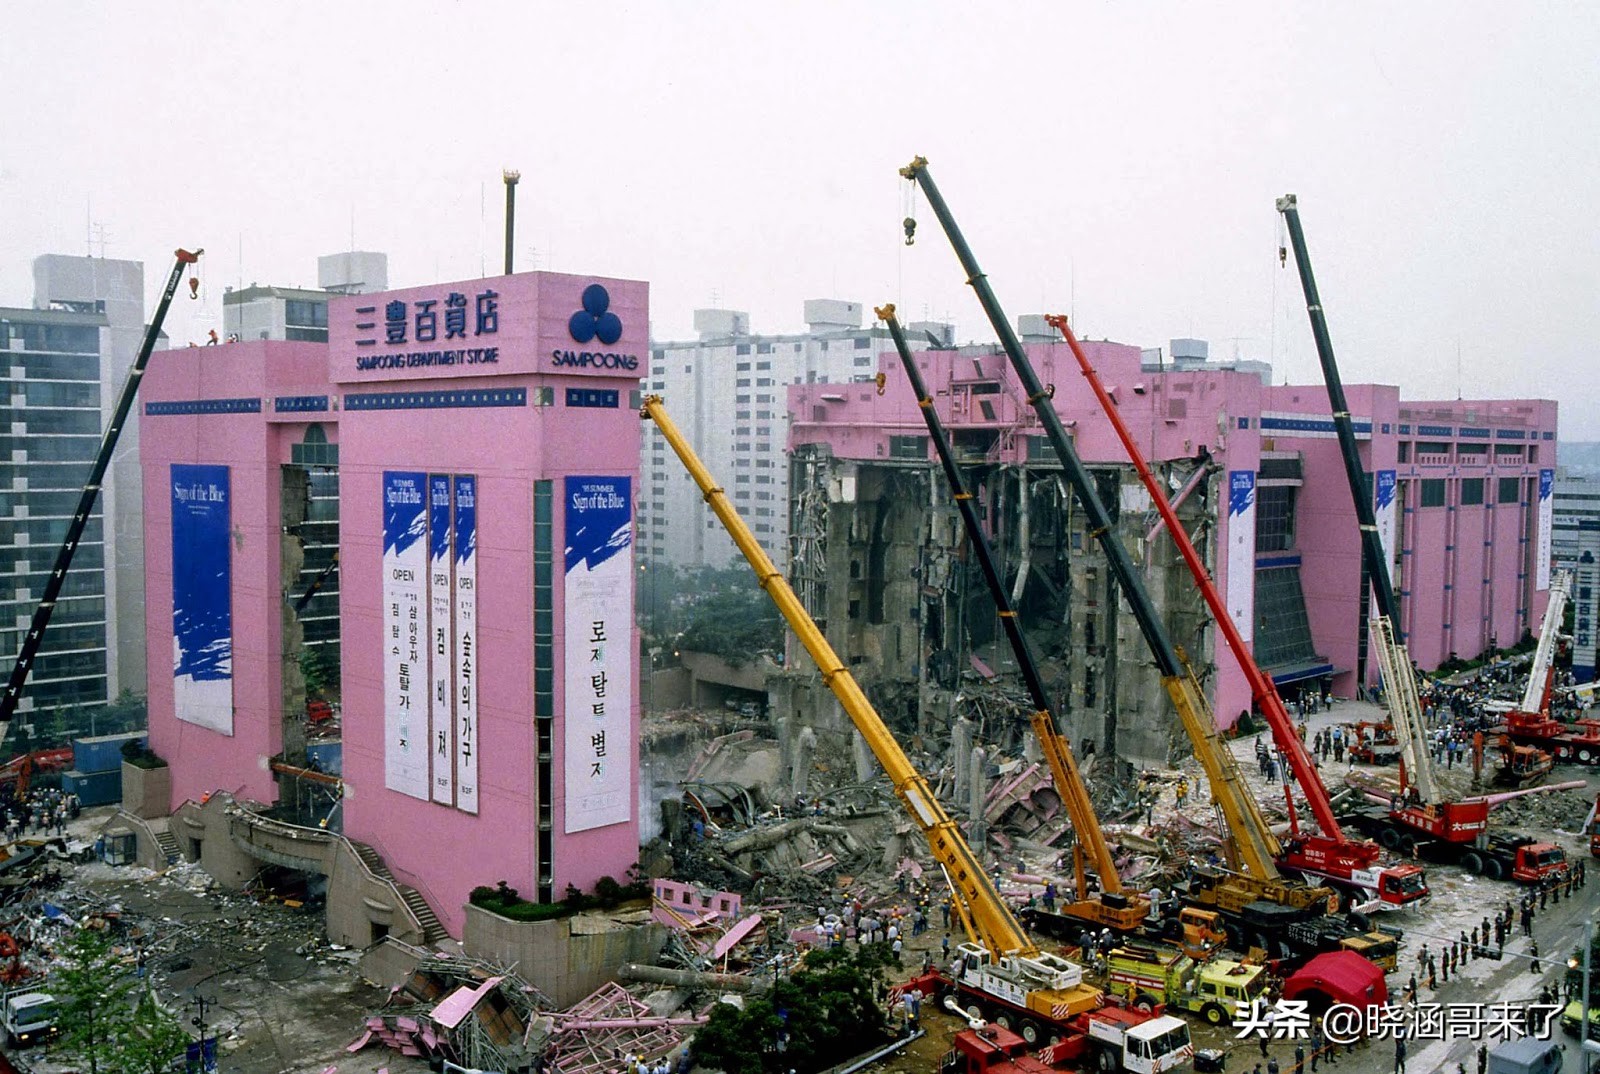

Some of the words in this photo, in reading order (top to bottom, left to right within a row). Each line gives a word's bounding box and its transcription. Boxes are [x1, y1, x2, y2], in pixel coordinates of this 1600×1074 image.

[355, 289, 499, 345] 三豐百貨店
[356, 353, 406, 371] SAMPOONG
[406, 349, 466, 369] DEPARTMENT
[466, 347, 499, 364] STORE
[552, 349, 639, 370] SAMPOONG
[209, 484, 225, 502] Blue
[573, 493, 588, 513] Sign
[589, 493, 598, 509] of
[597, 493, 608, 509] the
[608, 494, 625, 509] Blue
[393, 569, 414, 582] OPEN
[433, 574, 449, 587] OPEN
[459, 577, 473, 590] OPEN
